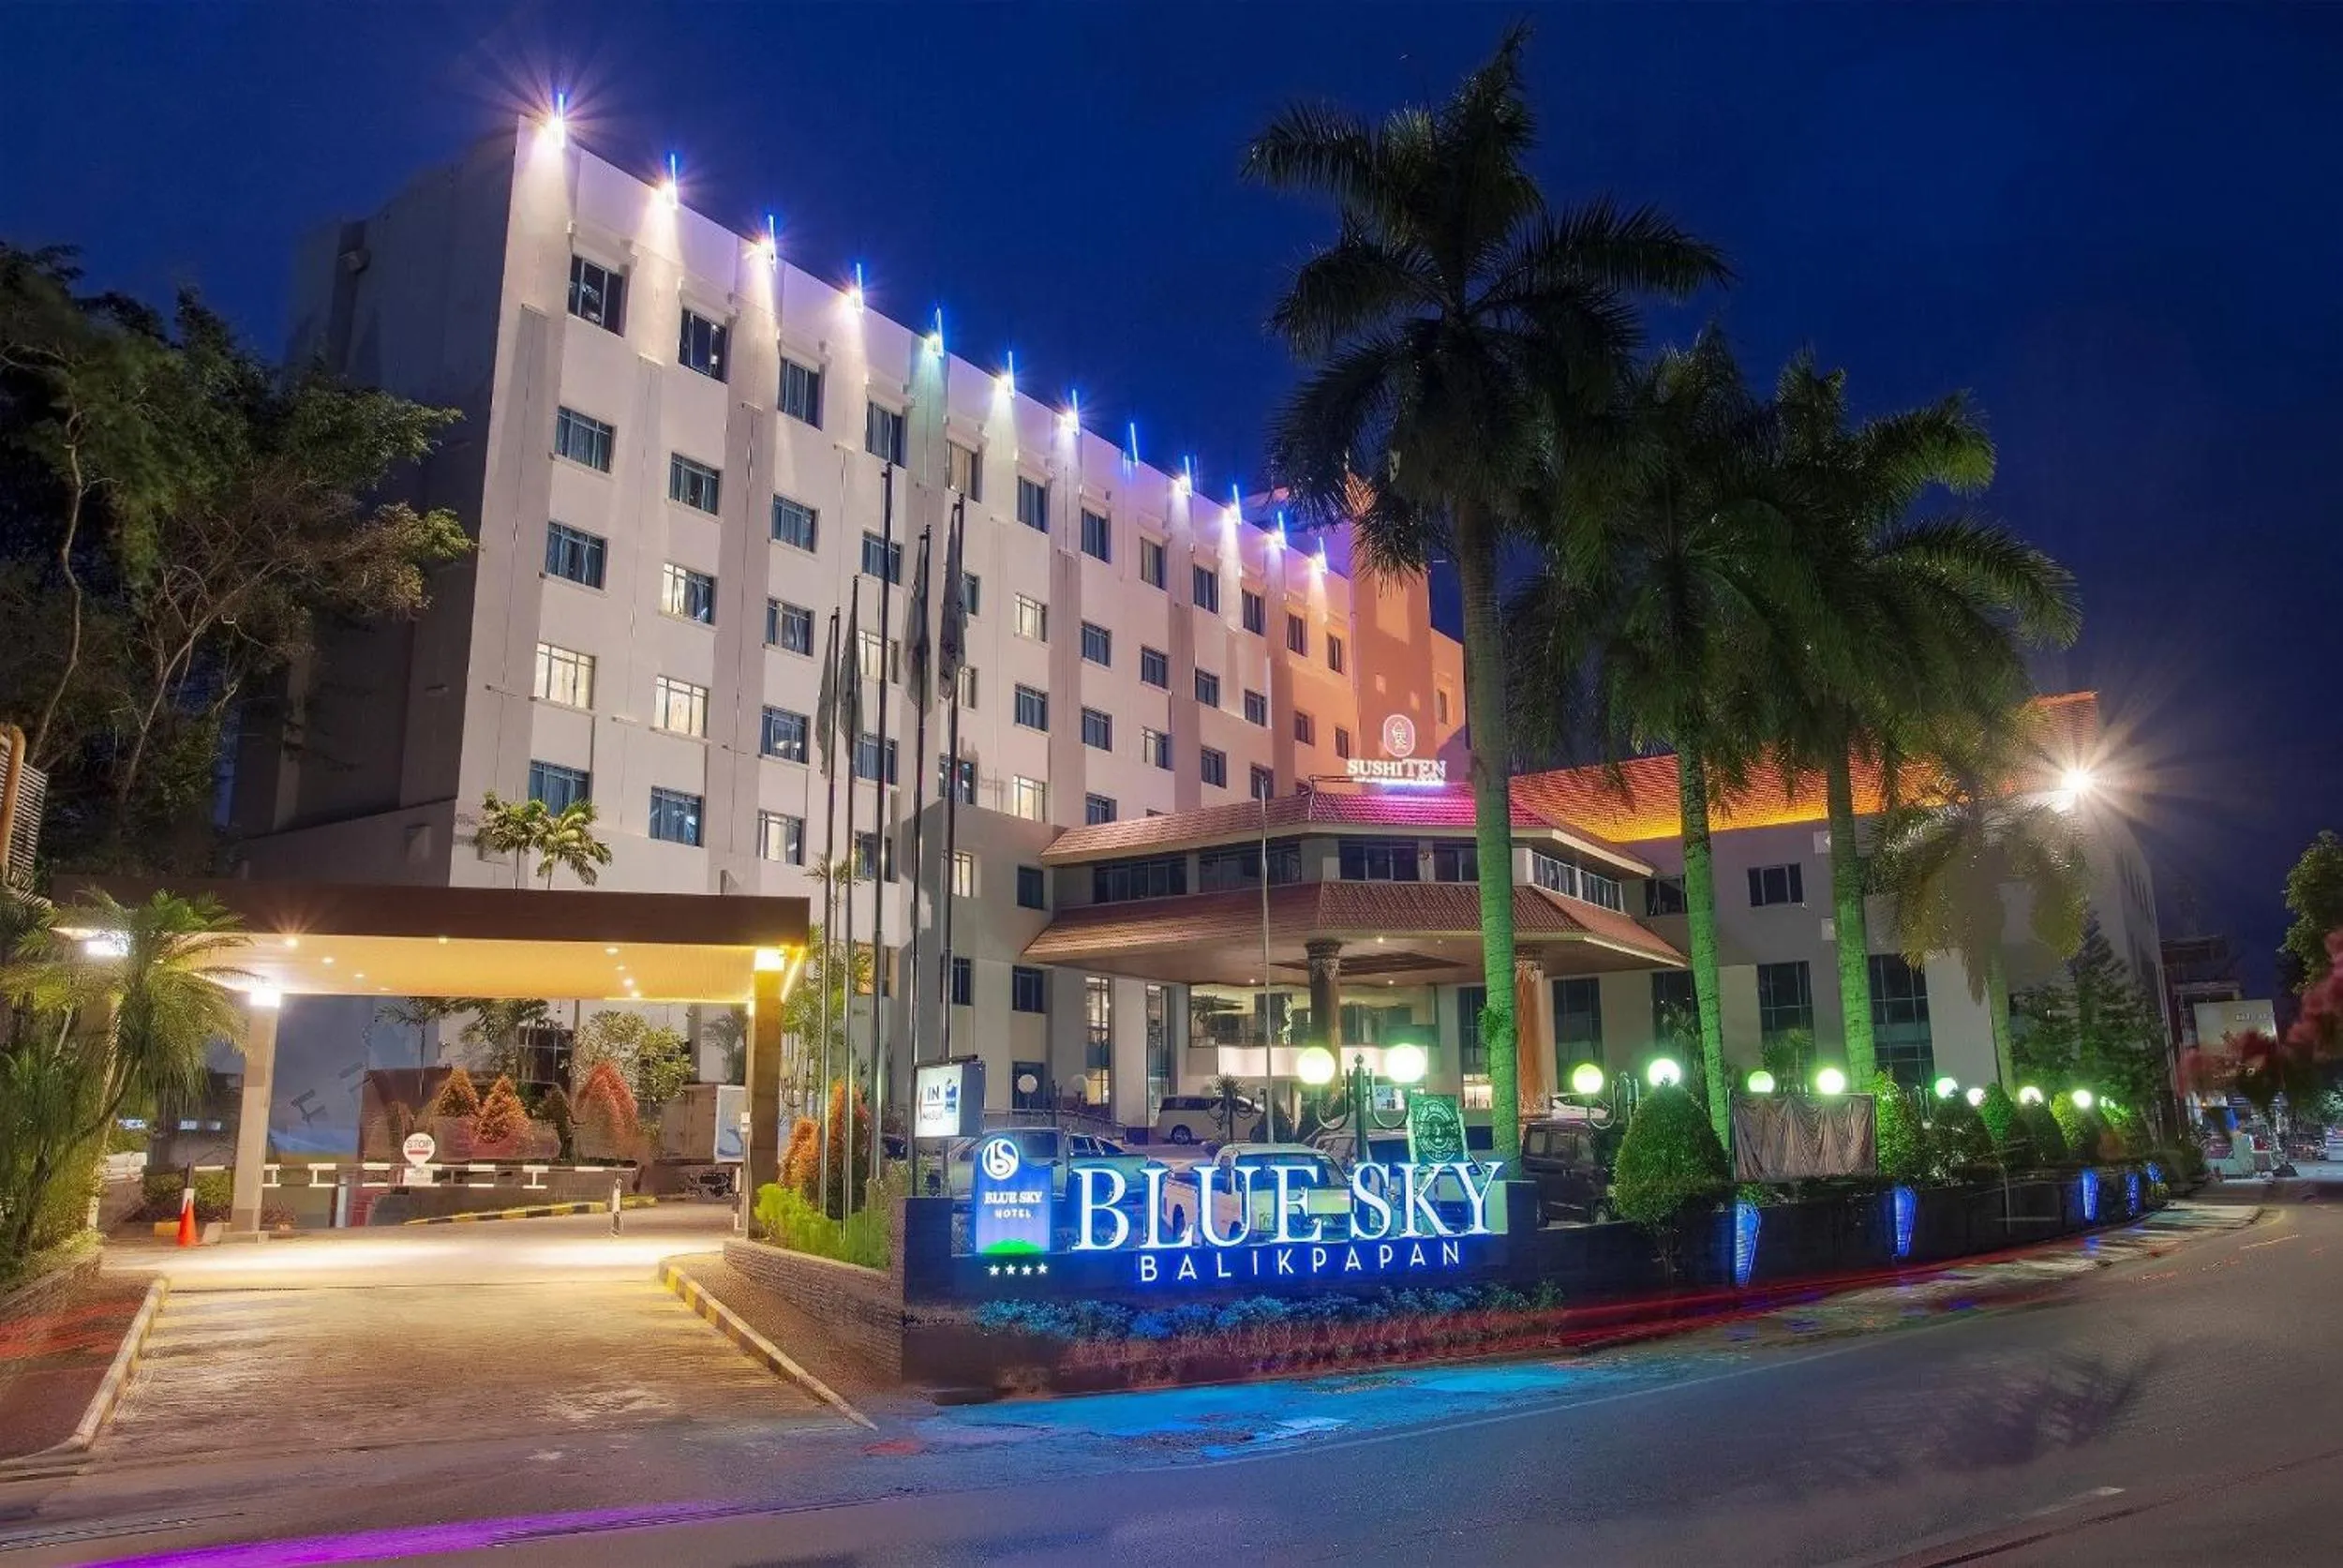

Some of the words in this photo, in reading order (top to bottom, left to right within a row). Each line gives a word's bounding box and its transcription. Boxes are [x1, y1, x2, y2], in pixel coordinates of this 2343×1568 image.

[1348, 759, 1403, 777] SUSHI
[1402, 758, 1447, 780] TEN
[927, 1085, 940, 1102] IN
[406, 1139, 432, 1149] STOP
[984, 1190, 1018, 1205] BLUE
[1019, 1190, 1043, 1203] SKY
[1070, 1164, 1322, 1252] BLUE
[1350, 1160, 1504, 1240] SKY
[994, 1208, 1032, 1219] HOTEL
[1140, 1240, 1460, 1283] BALIKPAPAN
